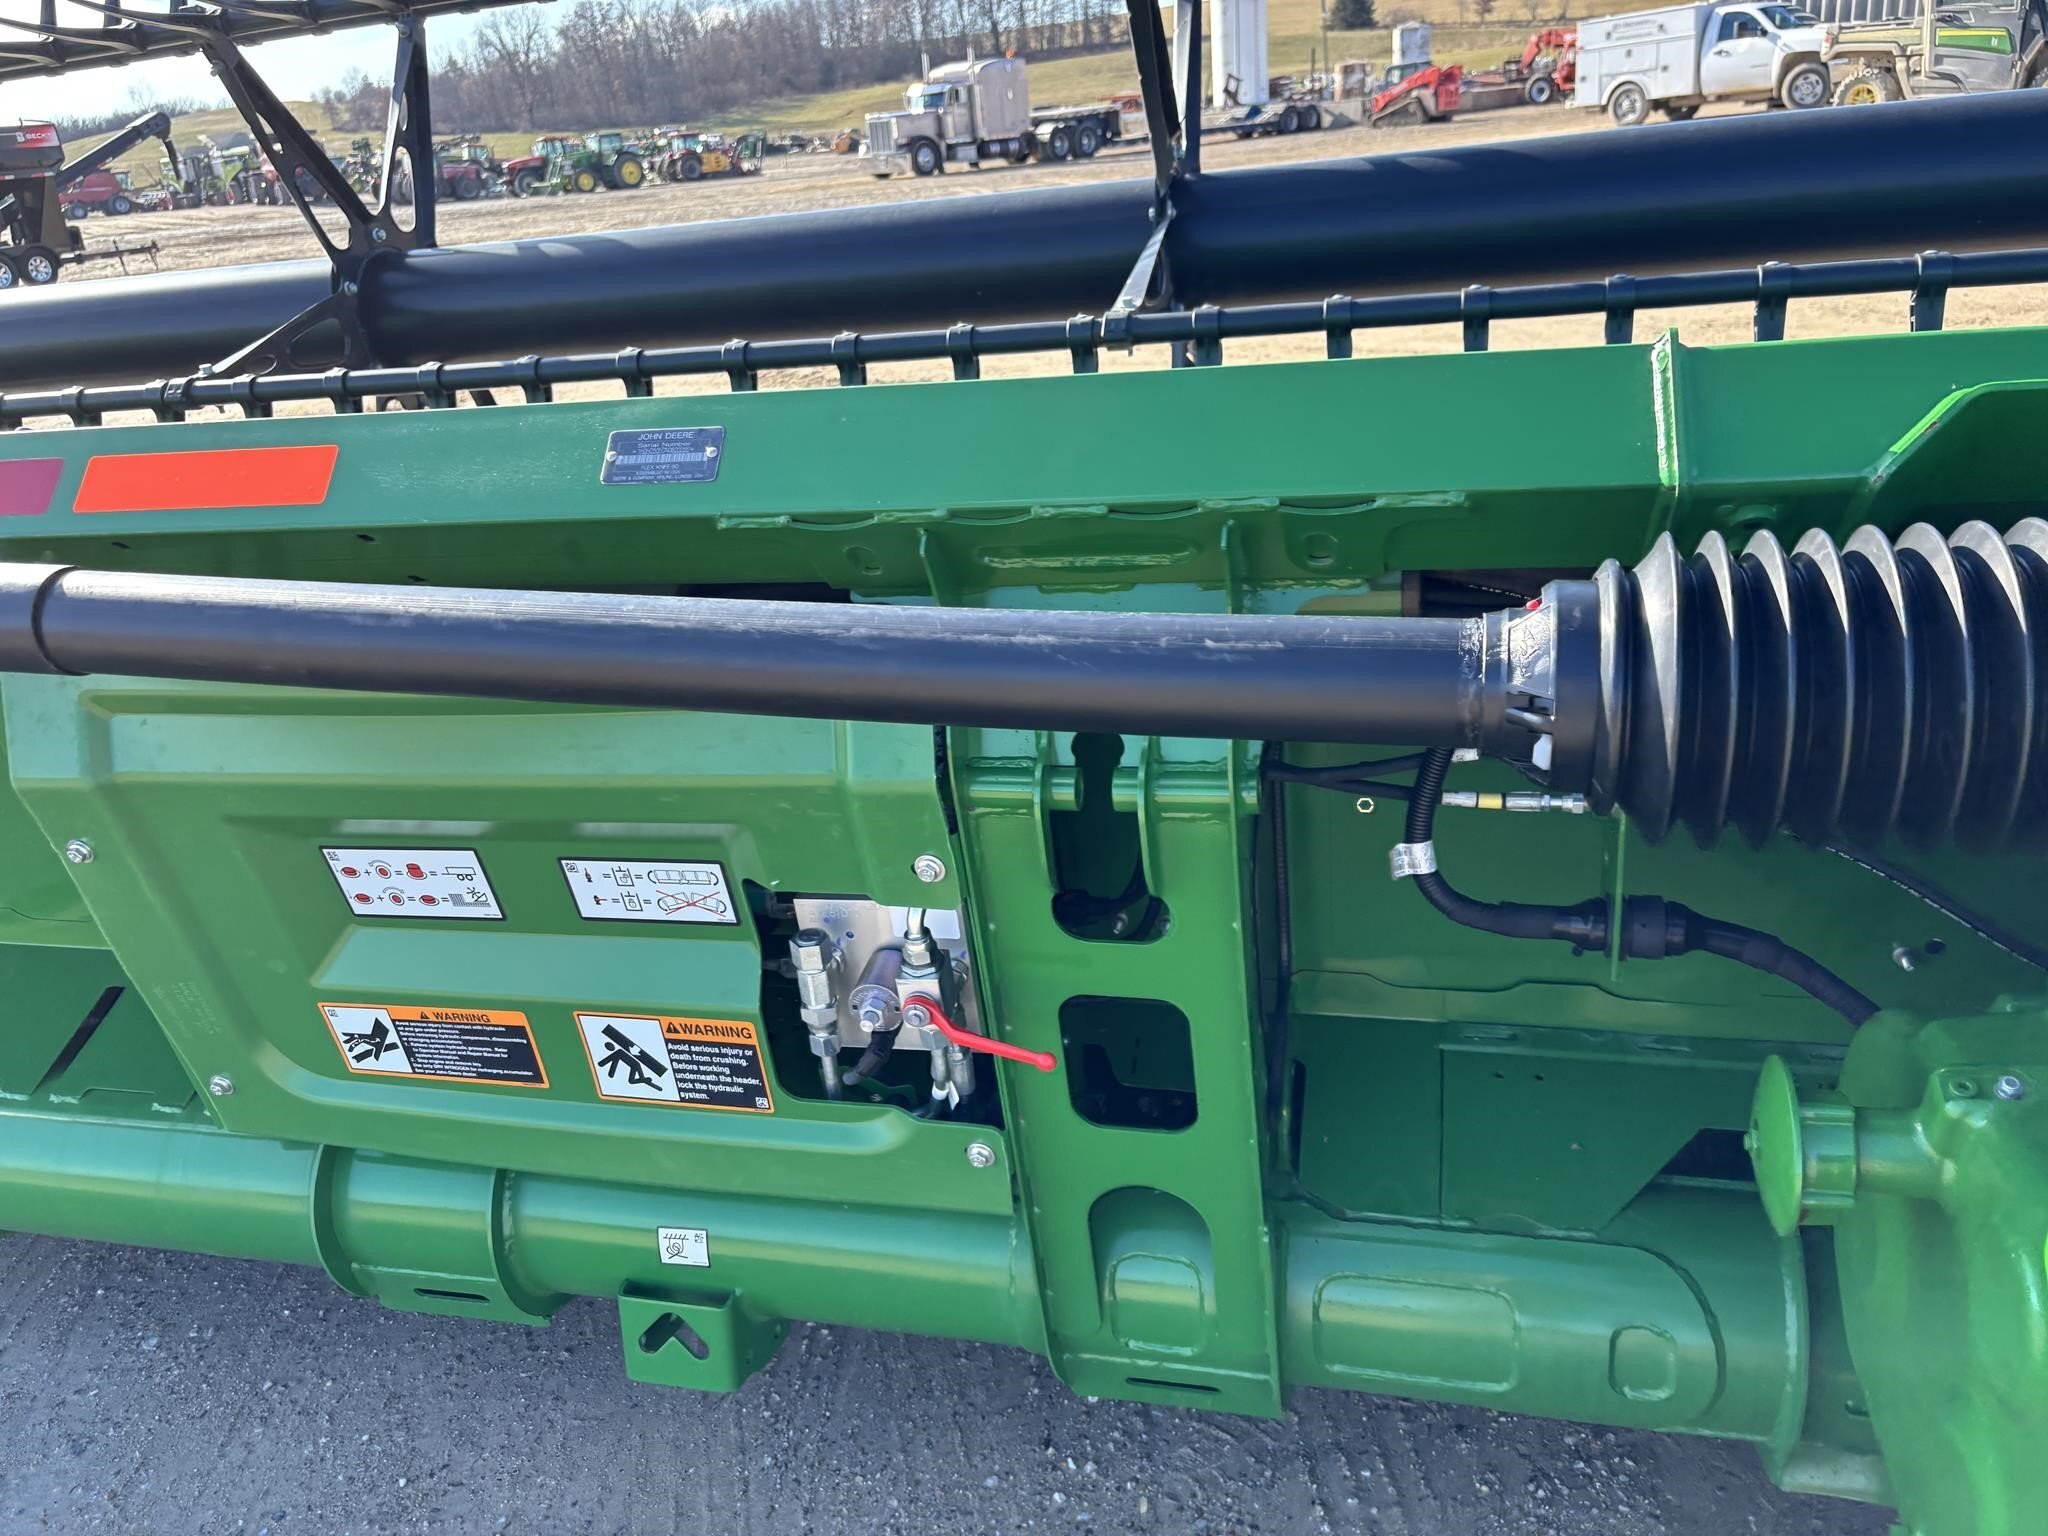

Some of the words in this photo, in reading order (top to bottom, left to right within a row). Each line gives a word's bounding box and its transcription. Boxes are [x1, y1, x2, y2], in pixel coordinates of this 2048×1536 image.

[638, 432, 662, 440] JOHN
[665, 431, 695, 439] DEERE
[432, 1011, 491, 1022] WARNING
[679, 1022, 753, 1039] WARNING
[667, 1042, 690, 1051] Avoid
[690, 1045, 719, 1053] serious
[720, 1046, 743, 1057] injury
[670, 1052, 692, 1060] death
[692, 1053, 711, 1062] from
[712, 1056, 749, 1067] crushing.
[672, 1062, 698, 1071] Before
[699, 1063, 730, 1074] working
[675, 1072, 719, 1082] underneath
[719, 1074, 732, 1083] the
[733, 1076, 762, 1086] header,
[677, 1081, 694, 1089] lock
[694, 1081, 708, 1090] the
[708, 1082, 744, 1093] hydraulic
[679, 1091, 710, 1100] system.
